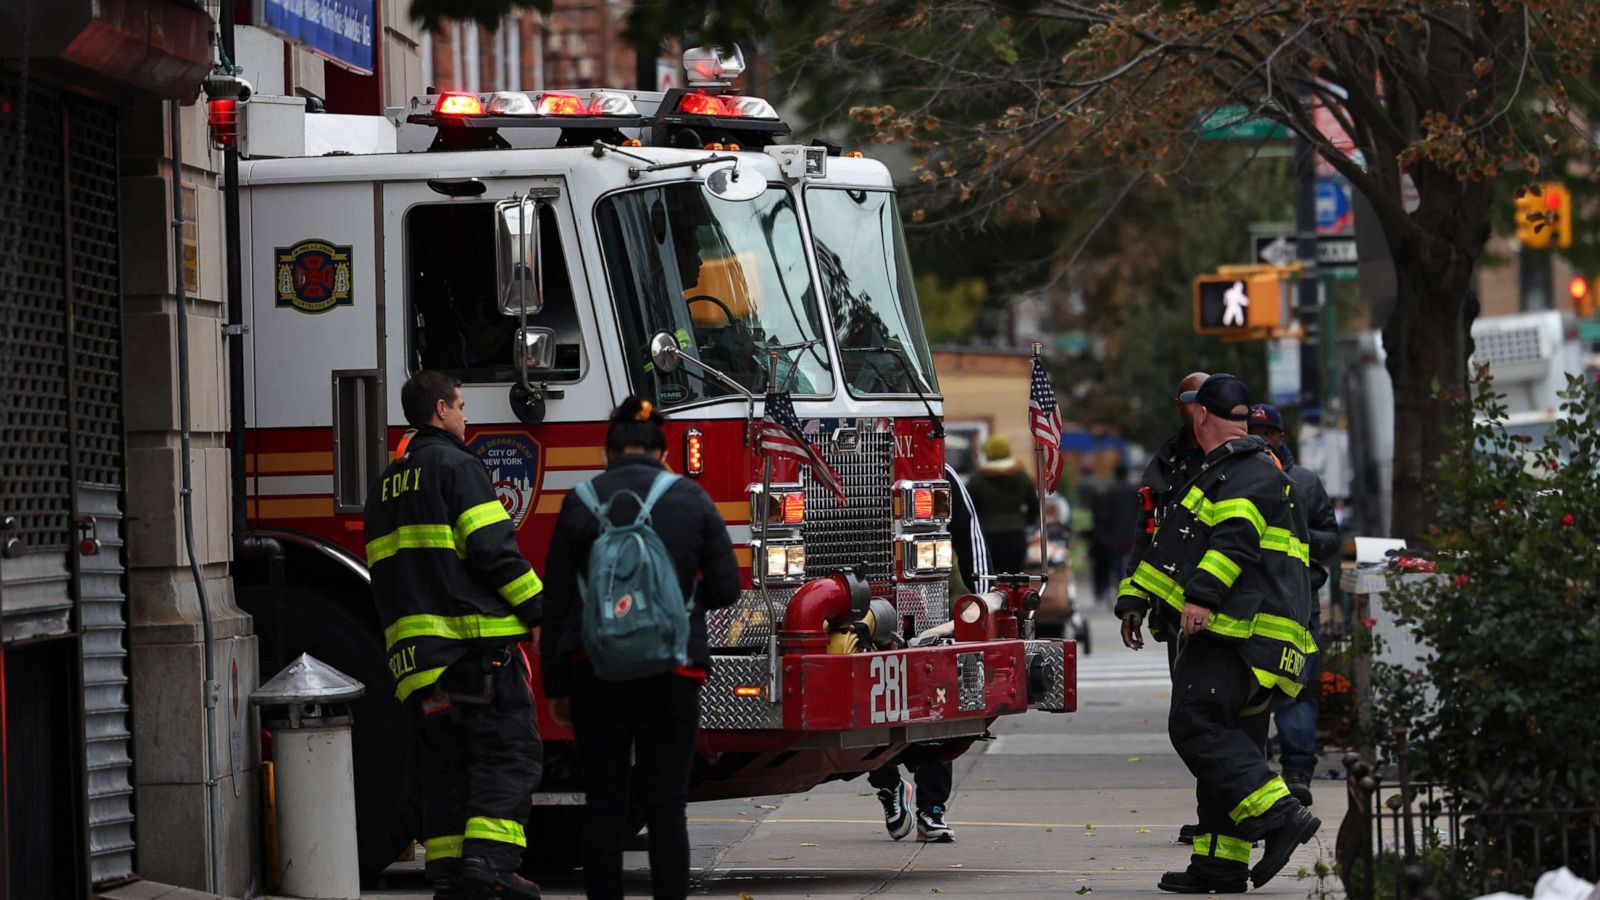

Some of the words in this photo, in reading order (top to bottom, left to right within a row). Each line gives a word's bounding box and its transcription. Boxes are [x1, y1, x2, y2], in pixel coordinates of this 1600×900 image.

[488, 449, 505, 457] CITY
[506, 449, 517, 457] OF
[483, 458, 500, 466] NEW
[502, 457, 523, 465] YORK
[870, 654, 910, 724] 281
